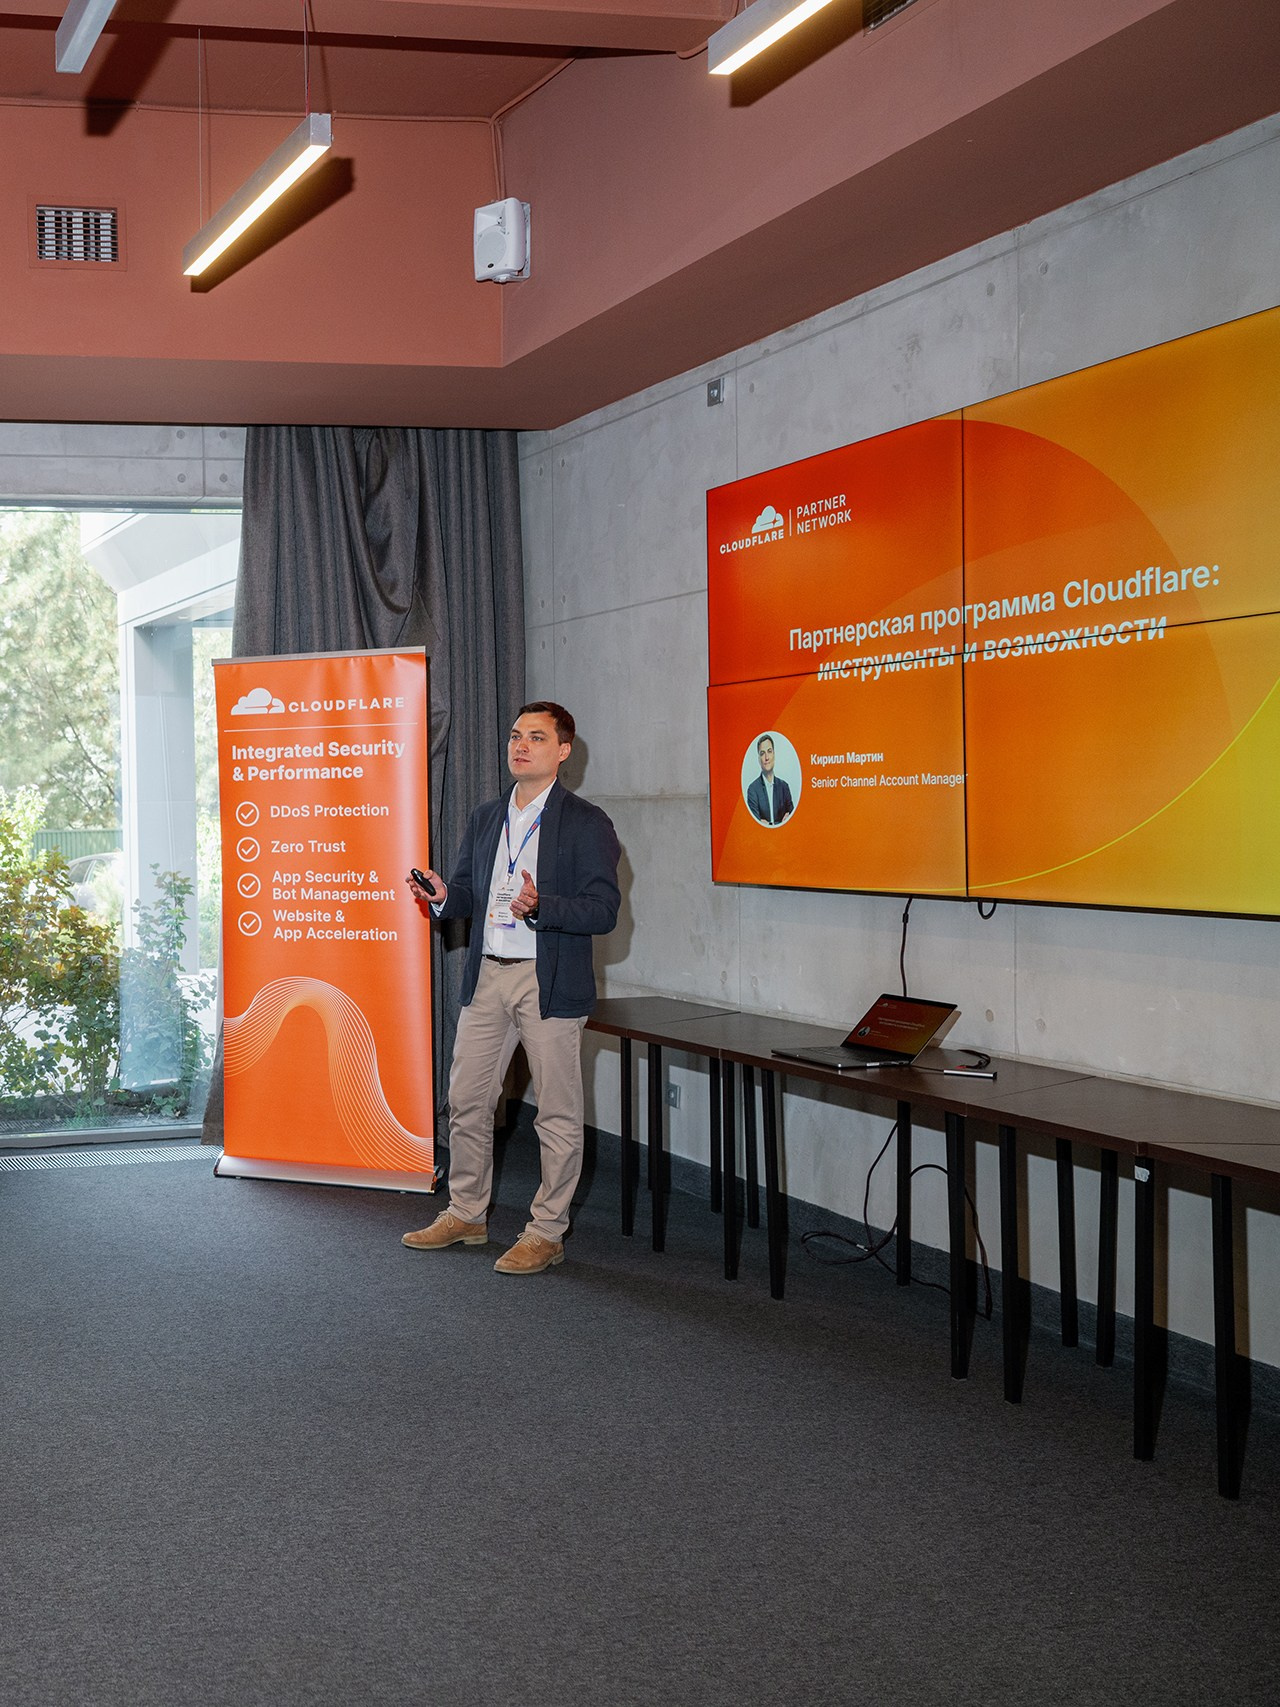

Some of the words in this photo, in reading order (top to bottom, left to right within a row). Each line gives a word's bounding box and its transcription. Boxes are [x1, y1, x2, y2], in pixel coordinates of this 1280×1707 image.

[796, 494, 846, 518] PARTNER
[796, 509, 852, 535] NETWORK
[720, 529, 784, 554] CLOUDFLARE
[789, 614, 914, 653] Партнерская
[920, 590, 1055, 635] программа
[1063, 564, 1220, 608] Cloudflare:
[817, 645, 956, 682] инструменты
[963, 643, 977, 663] и
[983, 616, 1167, 661] возможности
[288, 697, 405, 713] CLOUDFLARE
[232, 742, 324, 763] Integrated
[328, 739, 405, 759] Security
[810, 753, 844, 767] Кирилл
[846, 752, 884, 766] Мартин
[232, 767, 244, 781] &
[248, 766, 364, 781] Performance
[811, 776, 838, 788] Senior
[840, 775, 877, 788] Channel
[879, 774, 919, 787] Account
[921, 773, 968, 787] Manager
[270, 805, 310, 818] DDoS
[314, 803, 389, 817] Protection
[271, 840, 304, 853] Zero
[308, 840, 346, 853] Trust
[272, 871, 301, 886] App
[305, 870, 365, 886] Security
[369, 871, 379, 883] &
[272, 888, 297, 901] Bot
[300, 887, 395, 903] Management
[273, 909, 331, 923] Website
[335, 910, 345, 922] &
[273, 927, 302, 941] App
[306, 927, 398, 941] Acceleration
